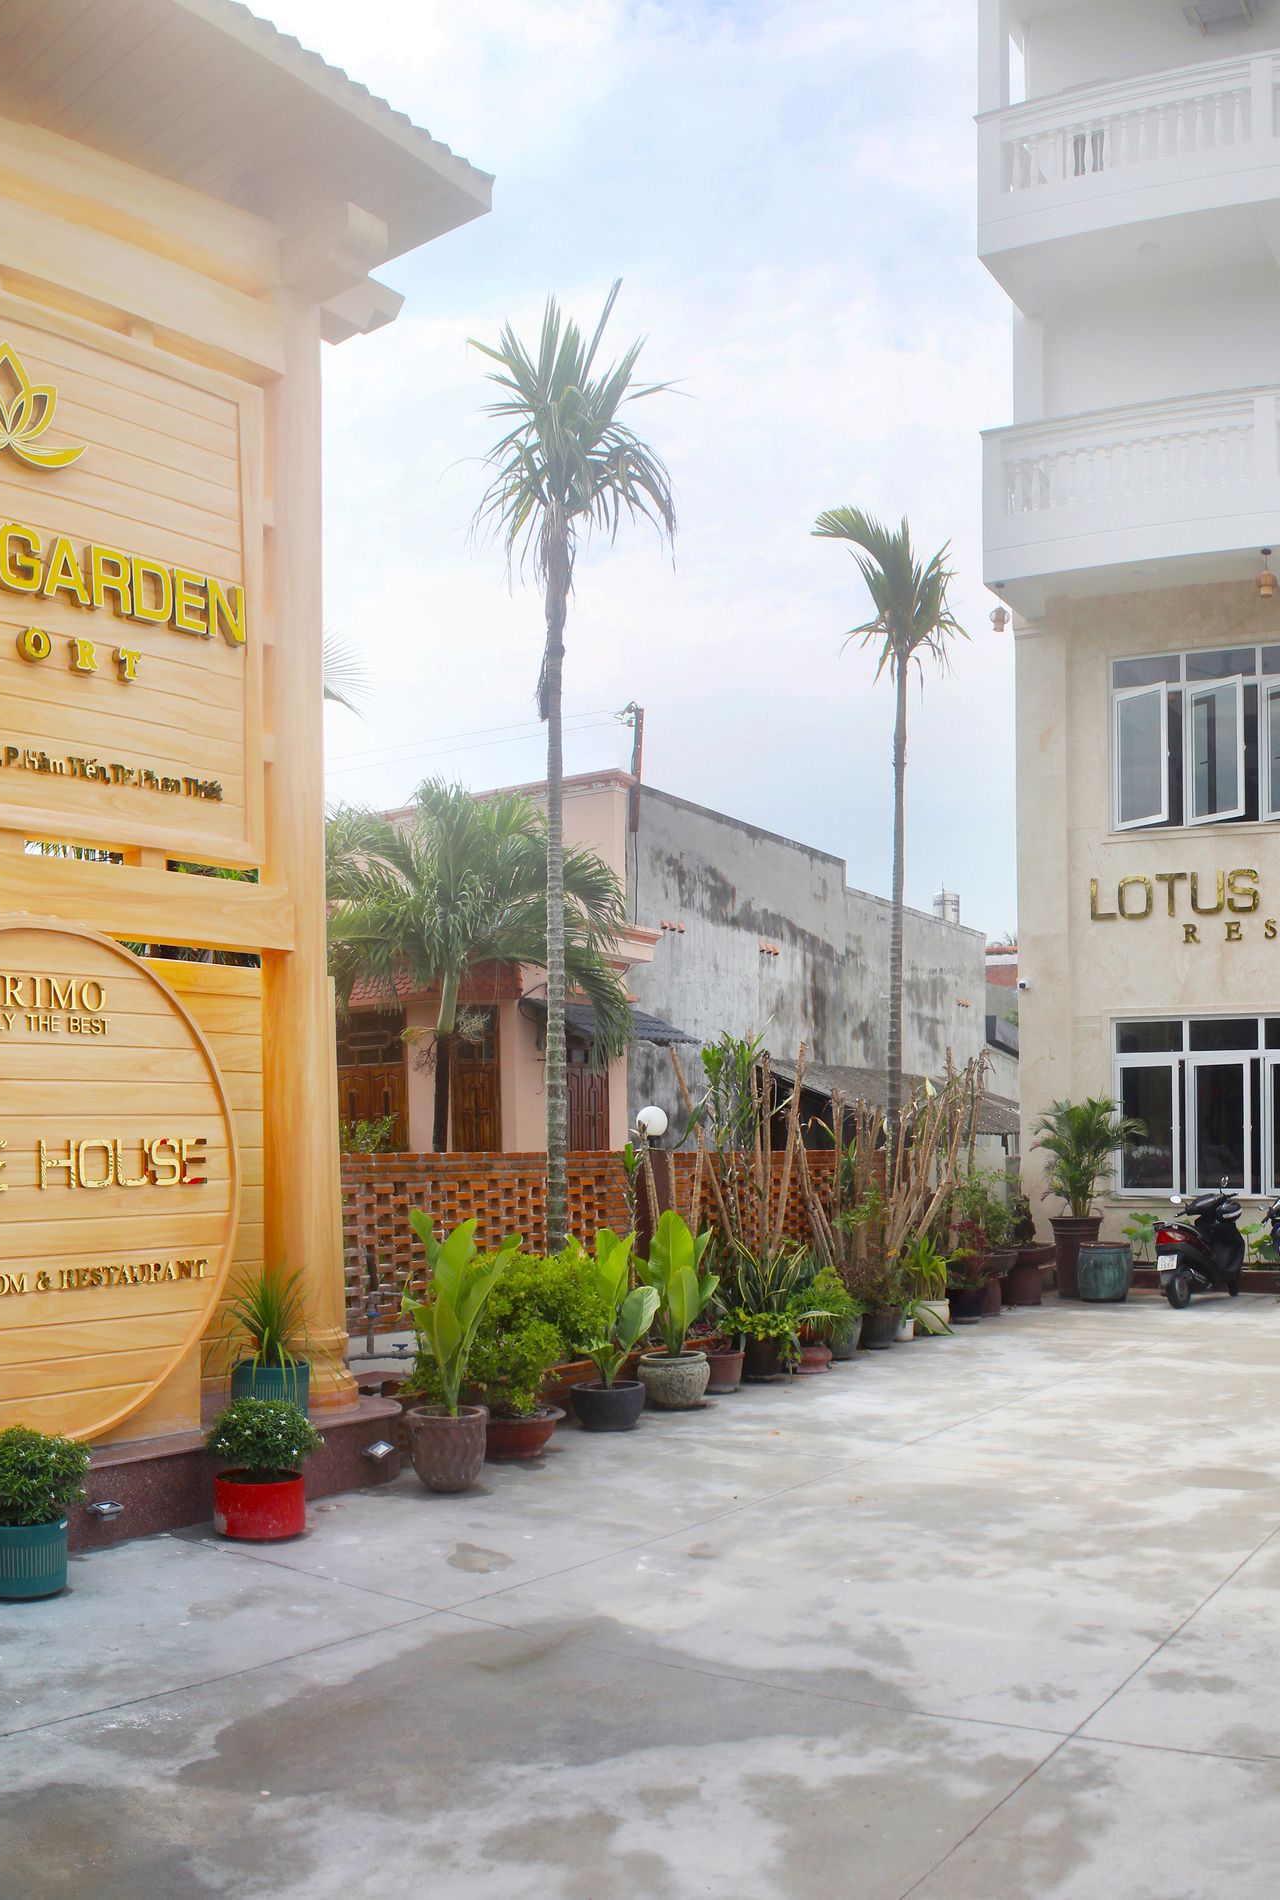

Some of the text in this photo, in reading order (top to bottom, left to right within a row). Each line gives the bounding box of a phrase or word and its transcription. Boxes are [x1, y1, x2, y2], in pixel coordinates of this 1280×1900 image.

[1090, 868, 1261, 920] LOTUS
[26, 1013, 62, 1032] THE
[68, 1016, 111, 1035] BEST
[38, 1138, 208, 1189] HOUSE
[36, 1270, 52, 1291] &
[59, 1259, 209, 1291] RESTAURANT
